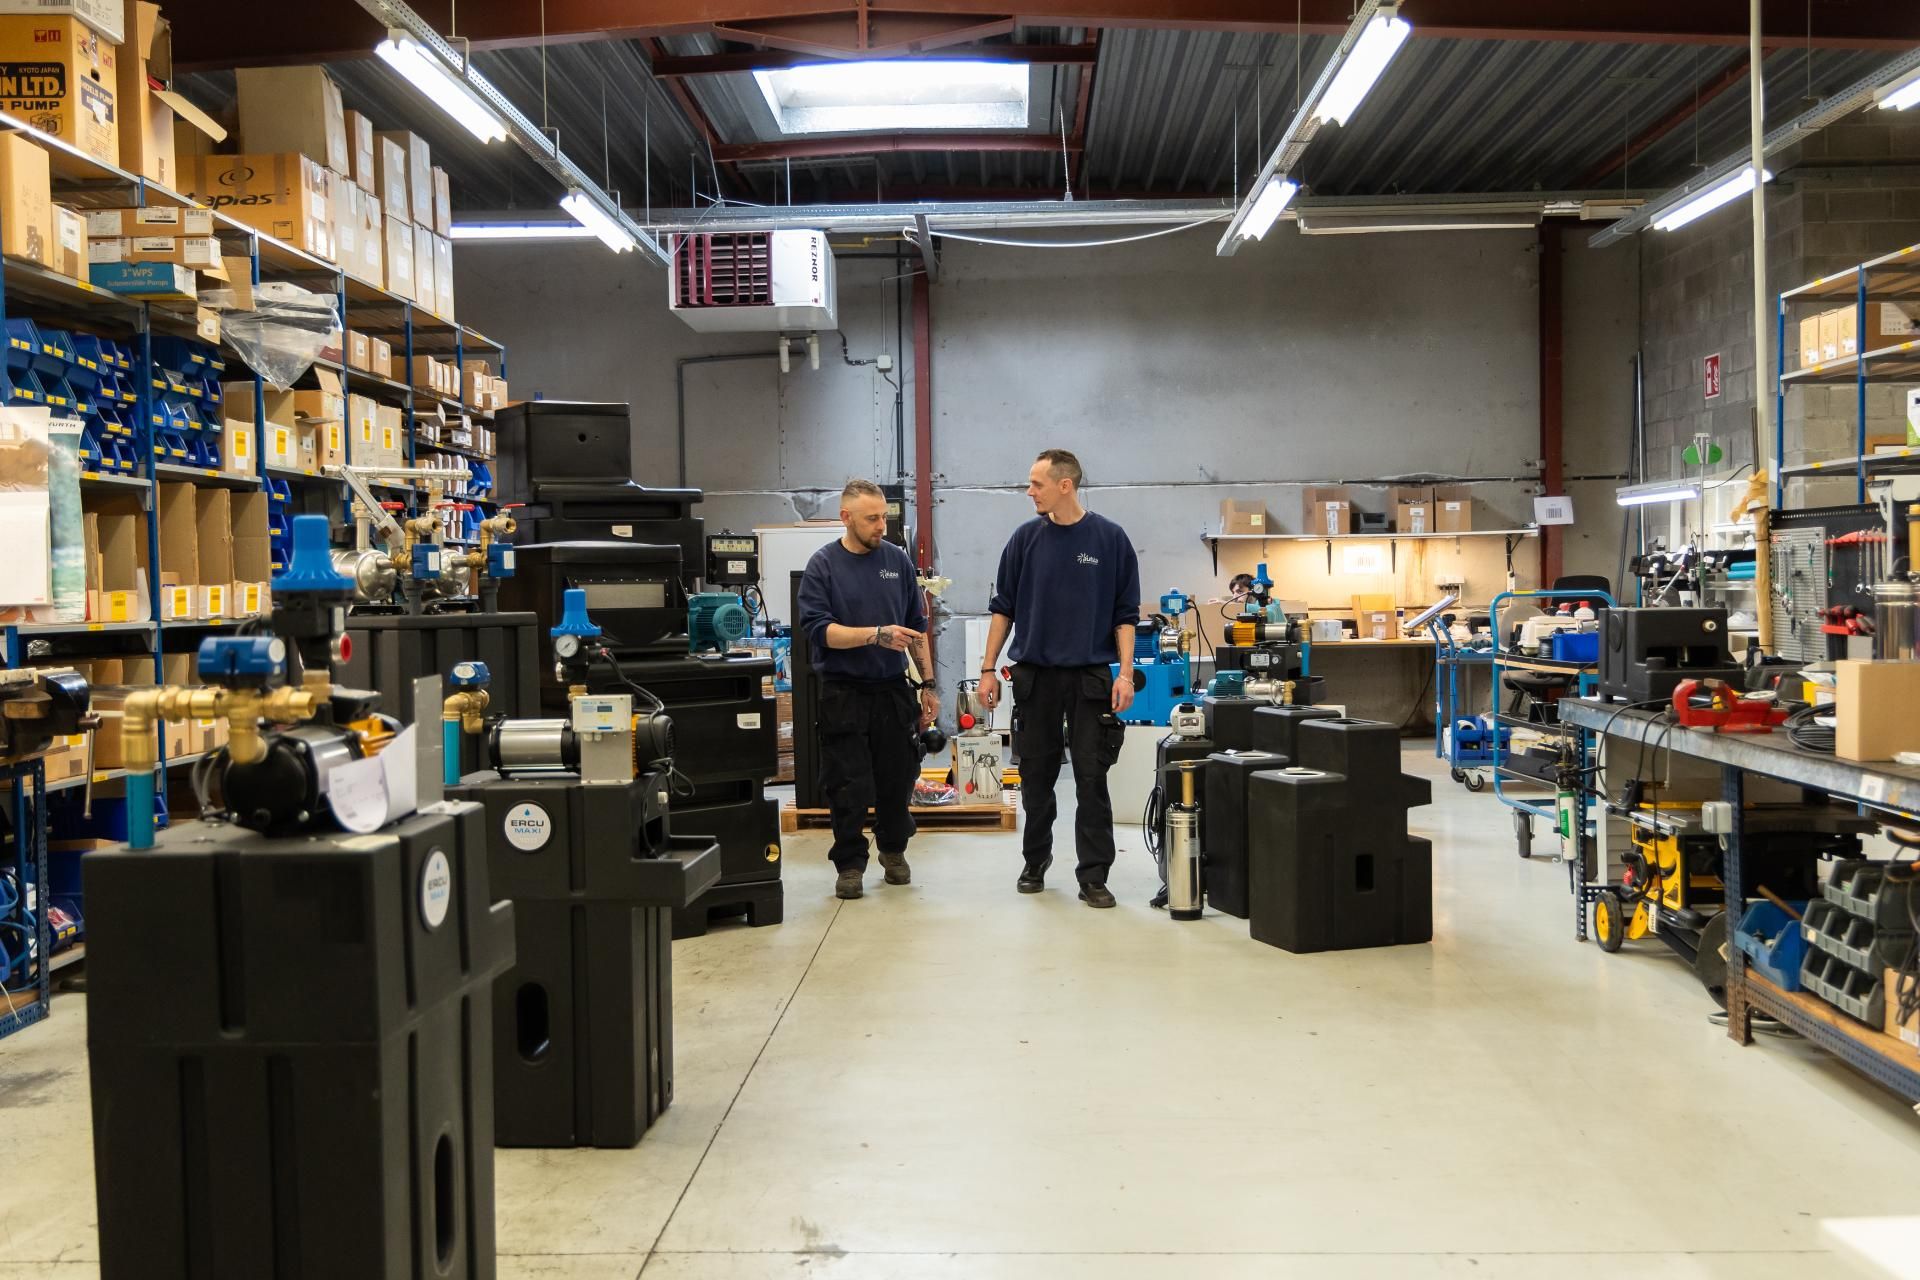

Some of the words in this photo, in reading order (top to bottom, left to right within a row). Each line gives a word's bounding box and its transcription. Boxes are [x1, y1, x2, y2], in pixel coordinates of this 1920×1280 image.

[0, 76, 17, 95] N
[22, 76, 64, 95] LTD.
[11, 101, 59, 110] PUMP
[511, 819, 545, 827] ERCU
[428, 875, 448, 890] ERCU
